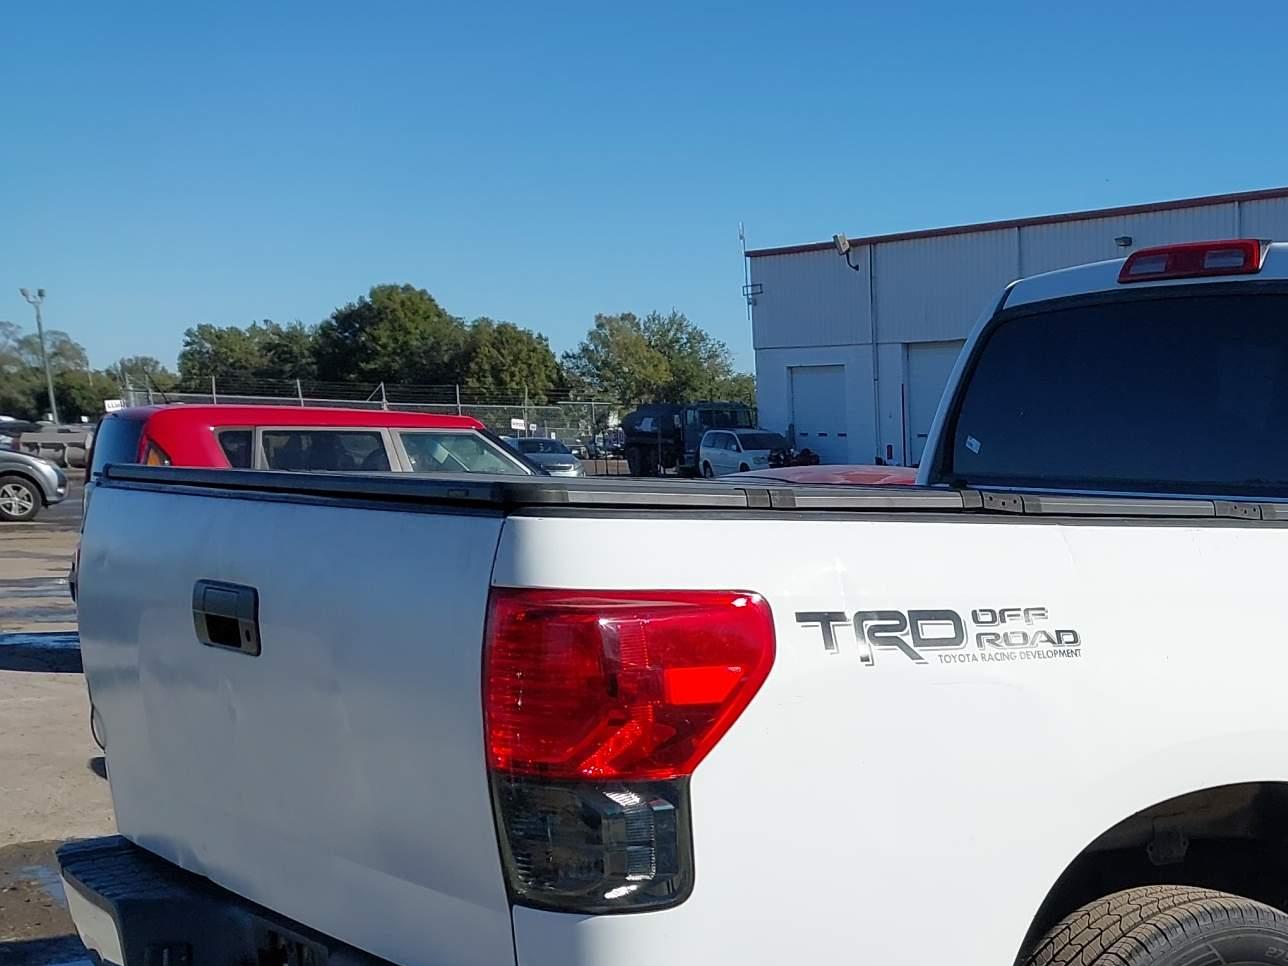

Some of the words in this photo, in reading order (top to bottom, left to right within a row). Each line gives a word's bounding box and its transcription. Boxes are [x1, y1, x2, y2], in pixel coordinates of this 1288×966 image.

[971, 606, 1050, 627] OFF
[795, 609, 968, 666] TRD
[975, 628, 1081, 650] ROAD
[938, 652, 979, 664] TOYOTA
[981, 651, 1017, 662] RACING
[1020, 648, 1082, 660] DEVELOPMENT
